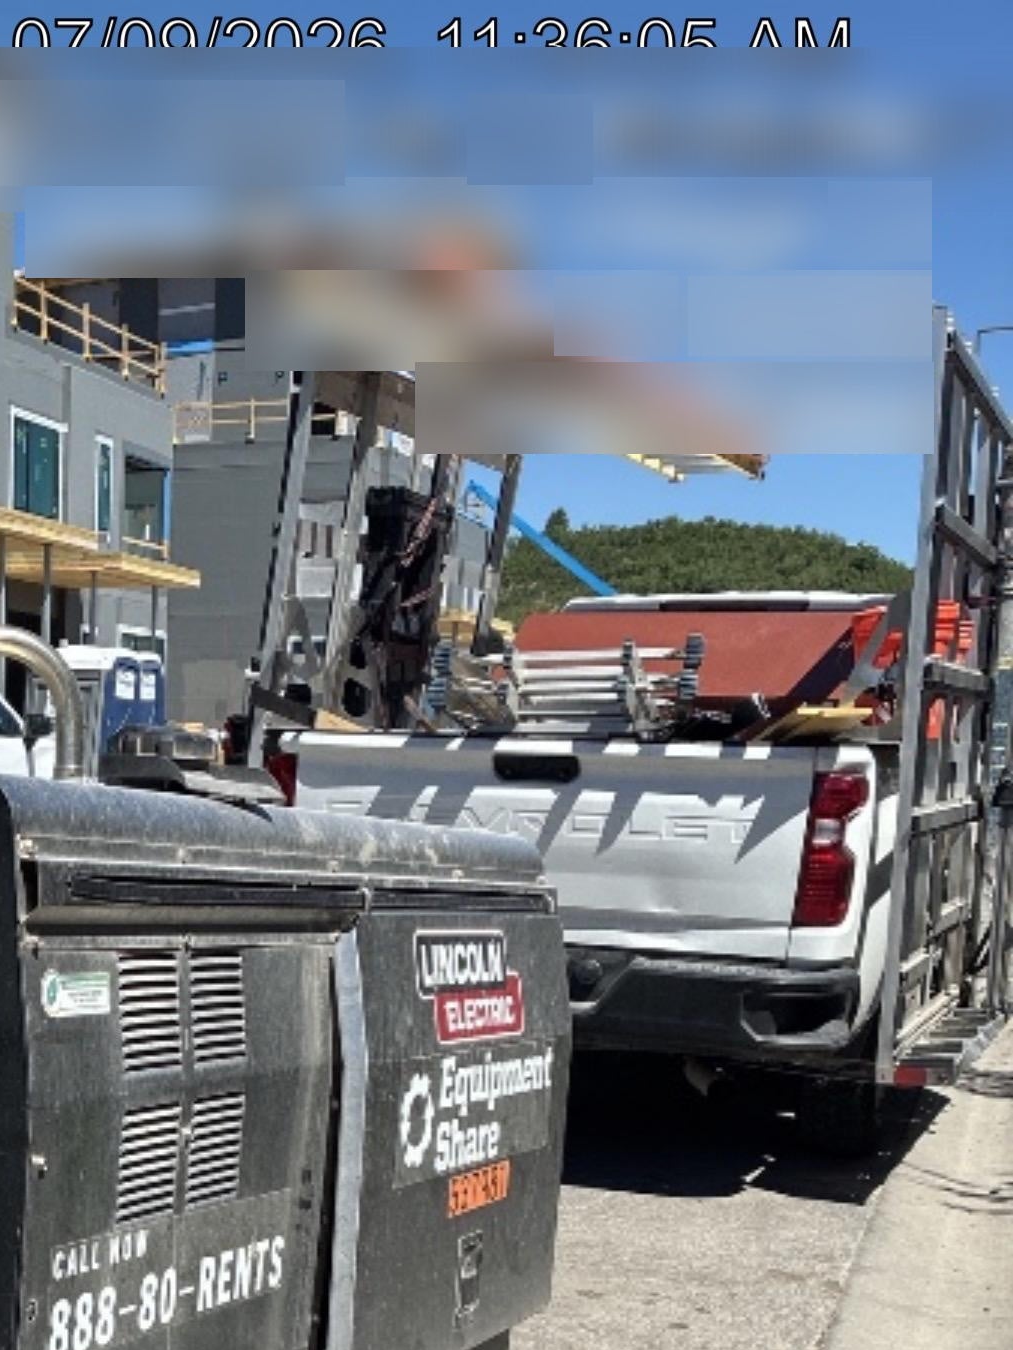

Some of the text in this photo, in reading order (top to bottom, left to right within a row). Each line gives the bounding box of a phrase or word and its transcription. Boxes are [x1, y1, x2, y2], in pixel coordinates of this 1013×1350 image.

[420, 938, 505, 988] LINCOLN
[444, 995, 516, 1033] ELECTRIC
[439, 1046, 554, 1117] Equipment
[434, 1118, 501, 1174] Share
[52, 1229, 149, 1281] CALL NOW
